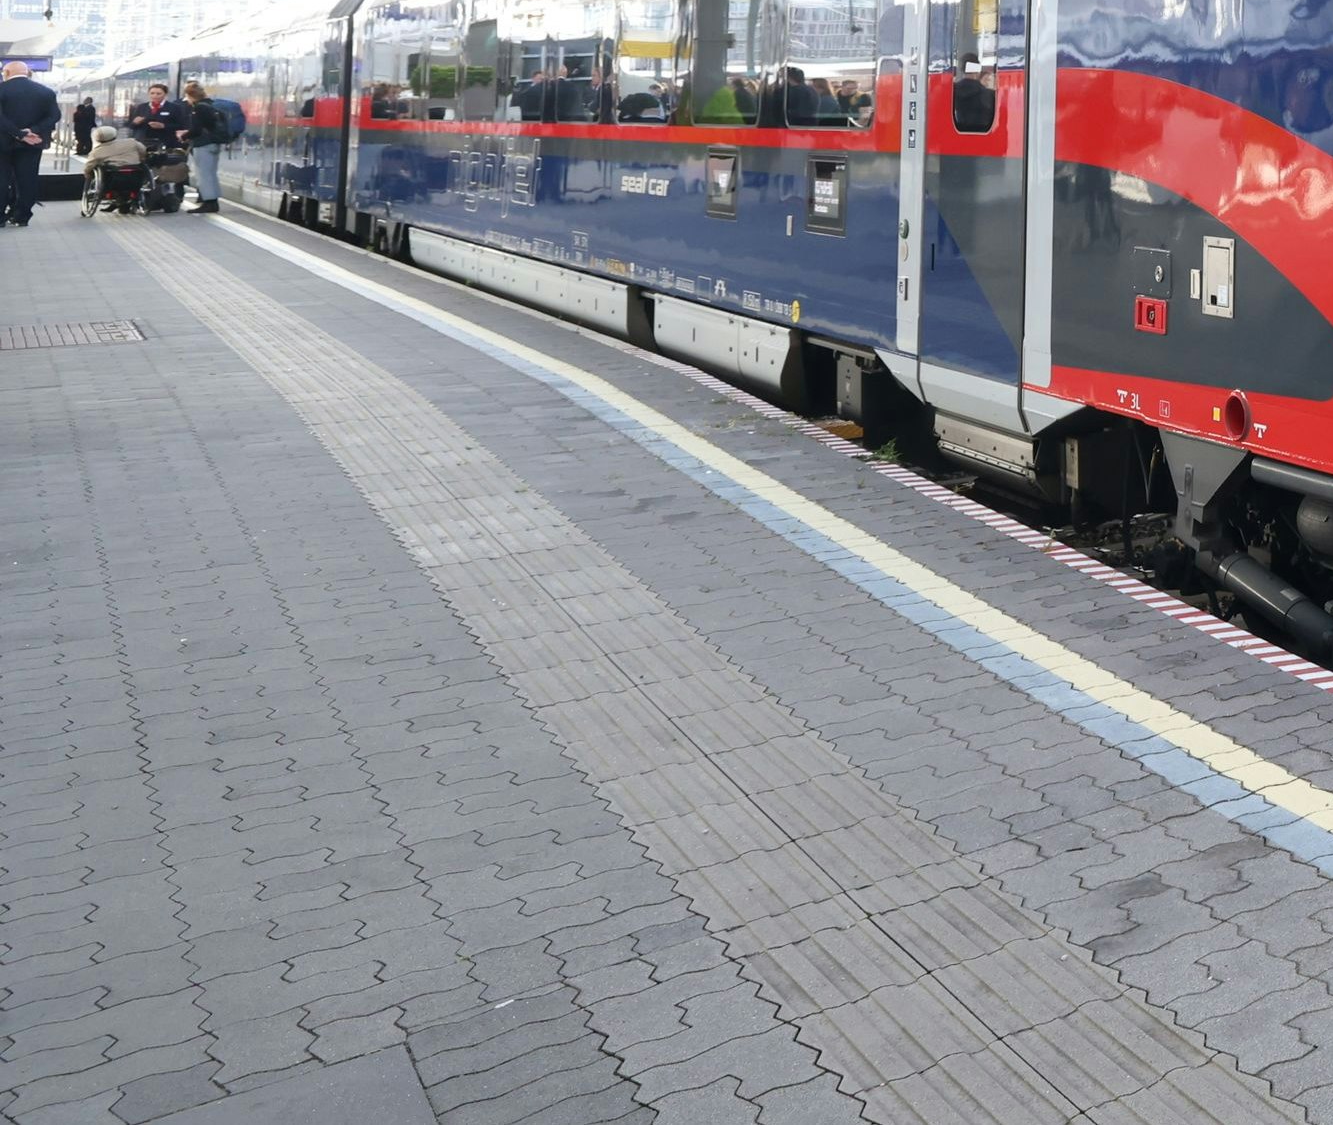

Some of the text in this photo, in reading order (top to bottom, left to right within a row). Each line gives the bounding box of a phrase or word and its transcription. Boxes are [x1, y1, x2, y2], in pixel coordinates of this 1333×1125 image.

[620, 171, 670, 197] seat car
[1130, 392, 1141, 410] 3L
